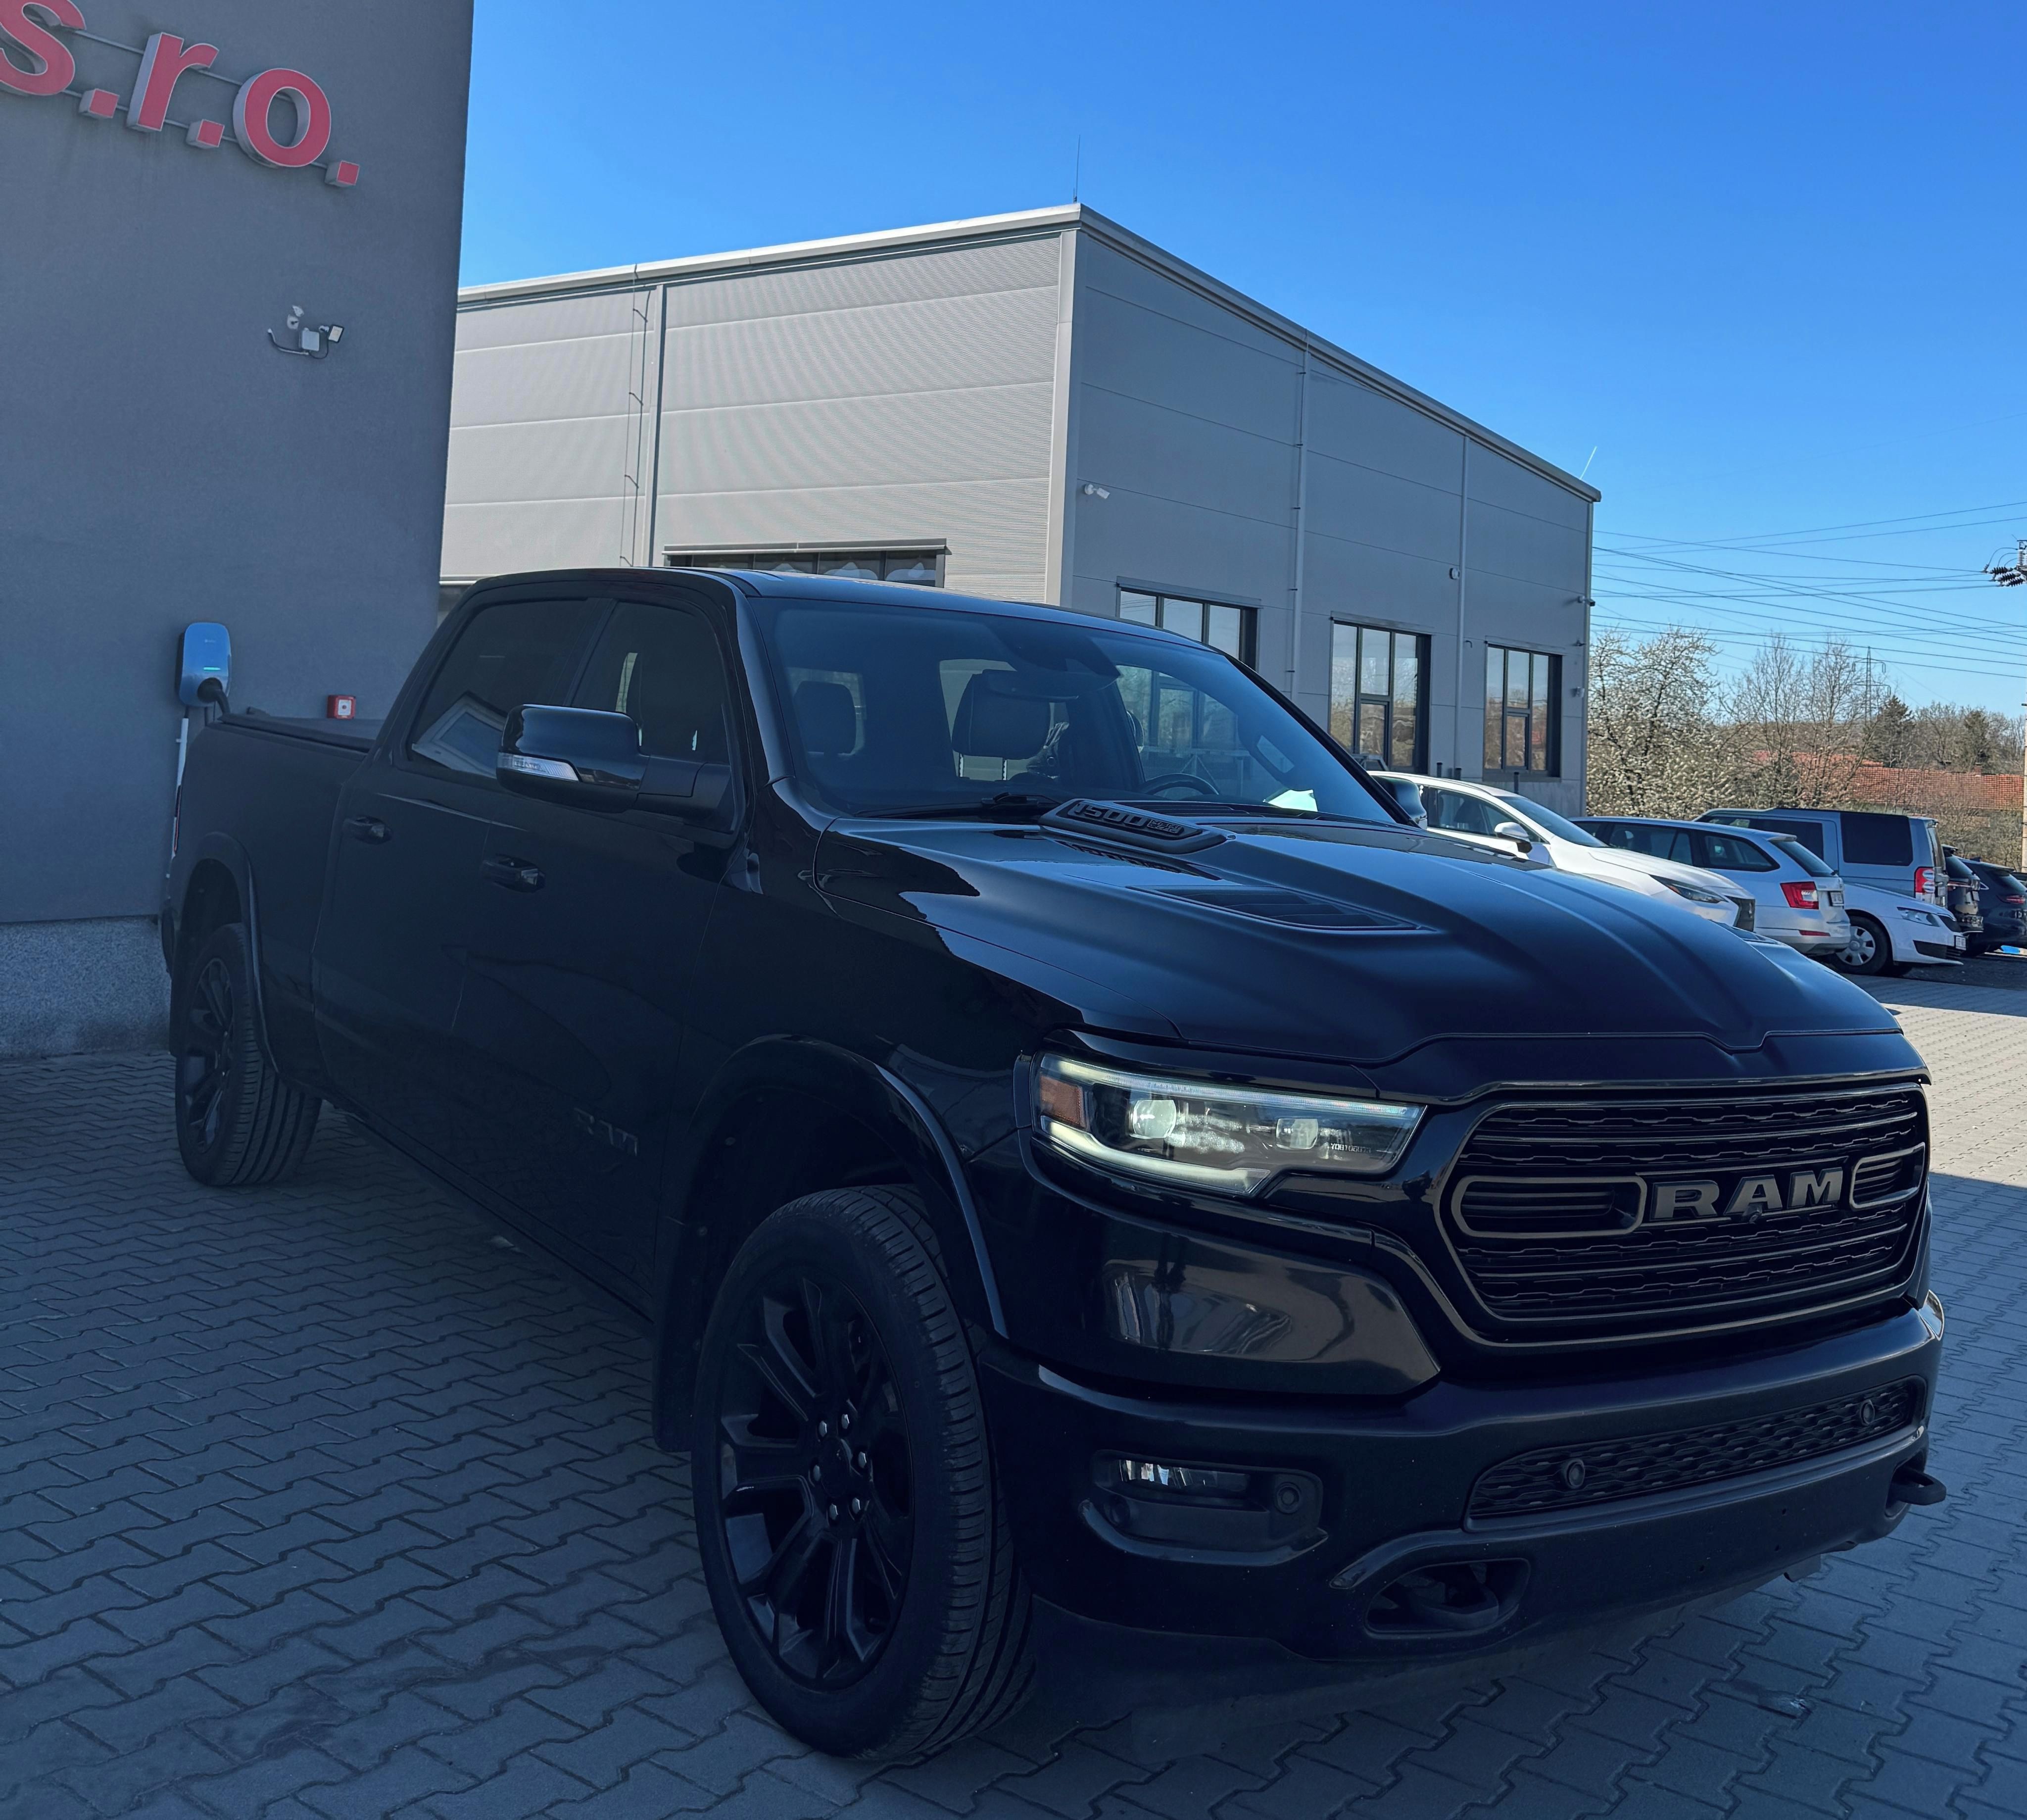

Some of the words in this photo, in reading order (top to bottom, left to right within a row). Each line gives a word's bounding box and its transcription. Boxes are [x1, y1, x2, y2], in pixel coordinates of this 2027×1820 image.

[0, 0, 359, 188] s.r.o.
[1074, 802, 1148, 827] 1500
[1649, 1167, 1843, 1222] RAM
